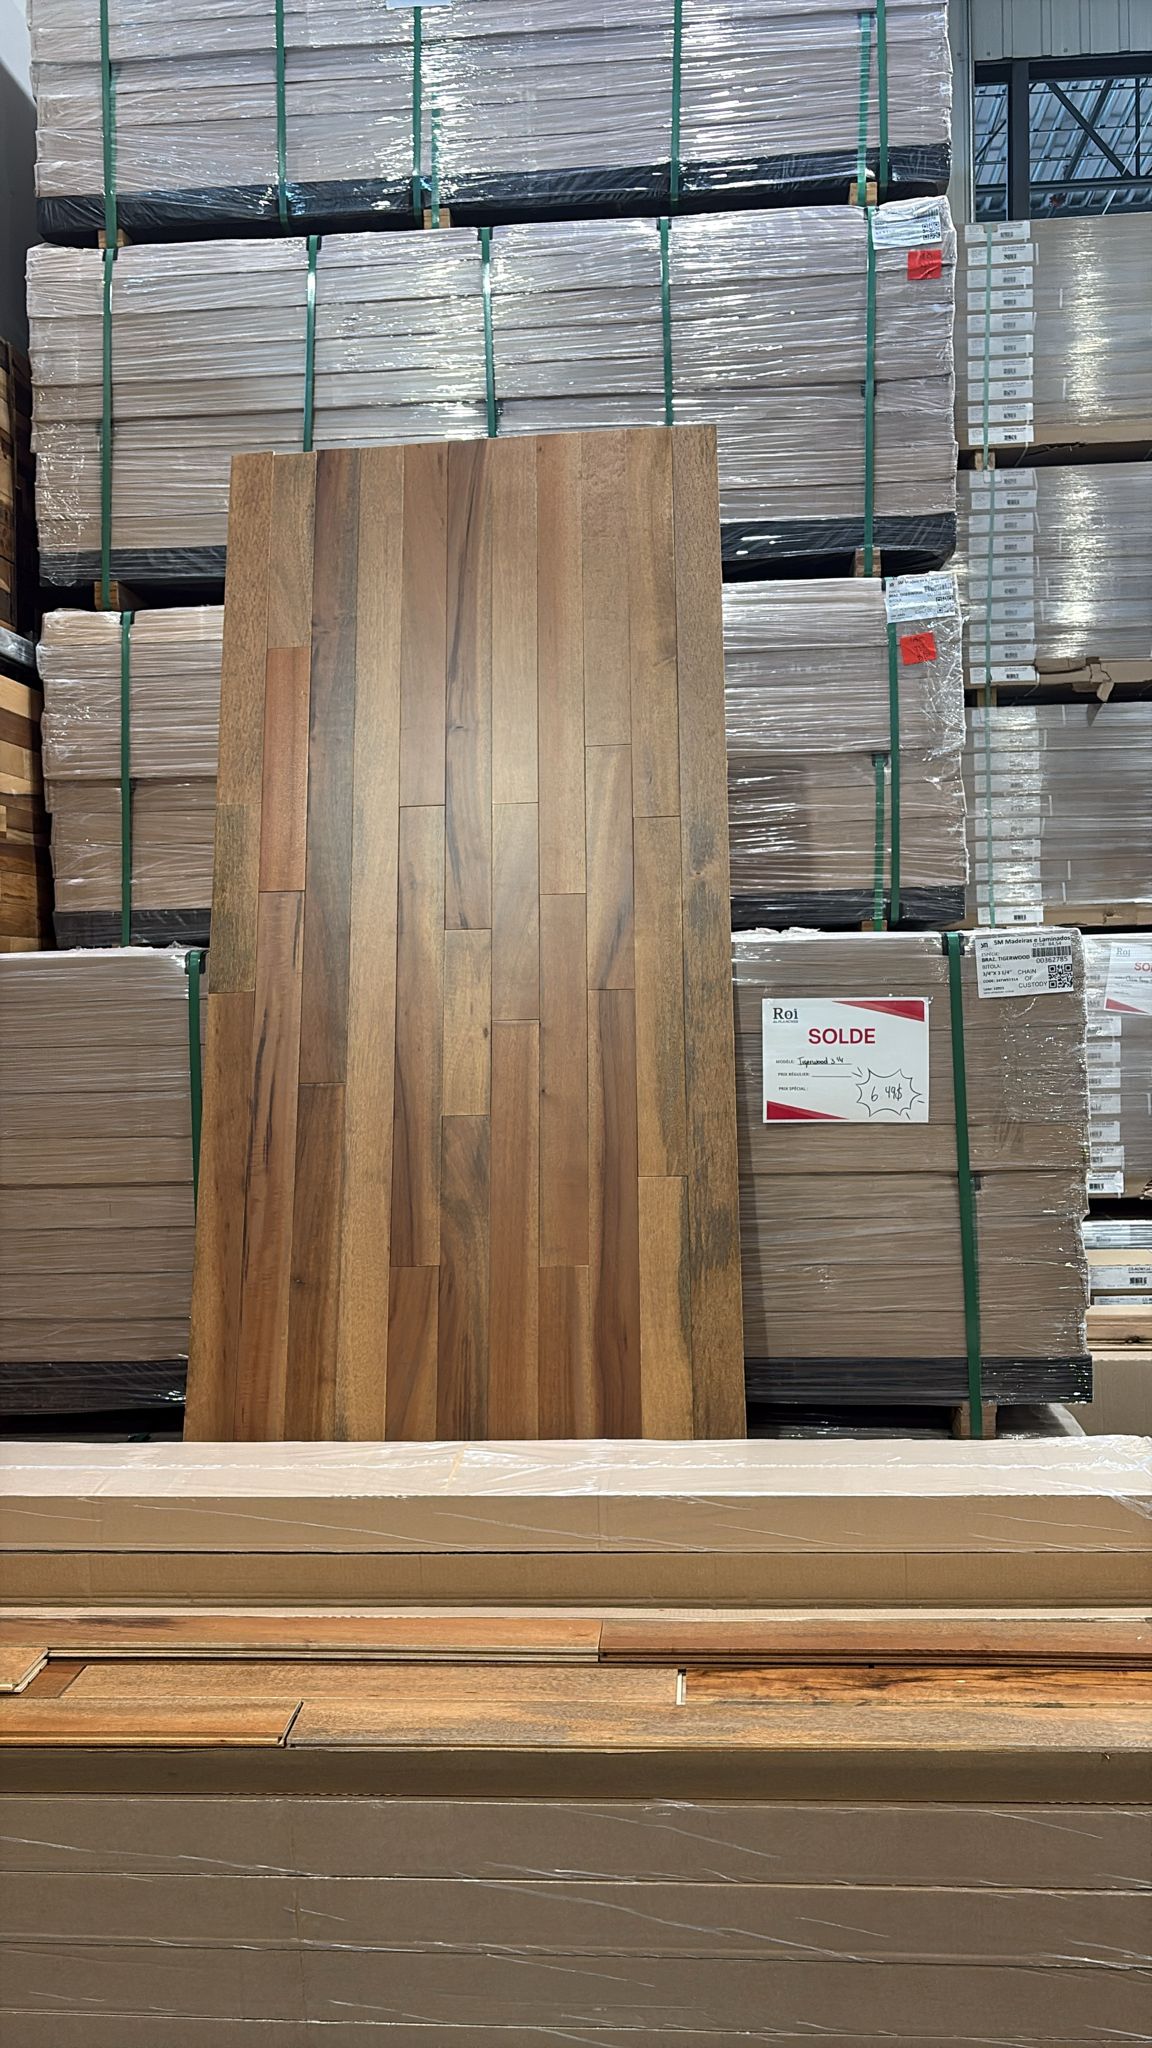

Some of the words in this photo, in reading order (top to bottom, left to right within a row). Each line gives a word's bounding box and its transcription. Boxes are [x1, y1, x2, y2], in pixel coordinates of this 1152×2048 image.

[1134, 962, 1152, 972] SO
[772, 1007, 798, 1020] Roi
[808, 1028, 876, 1044] SOLDE
[870, 1086, 878, 1102] 6
